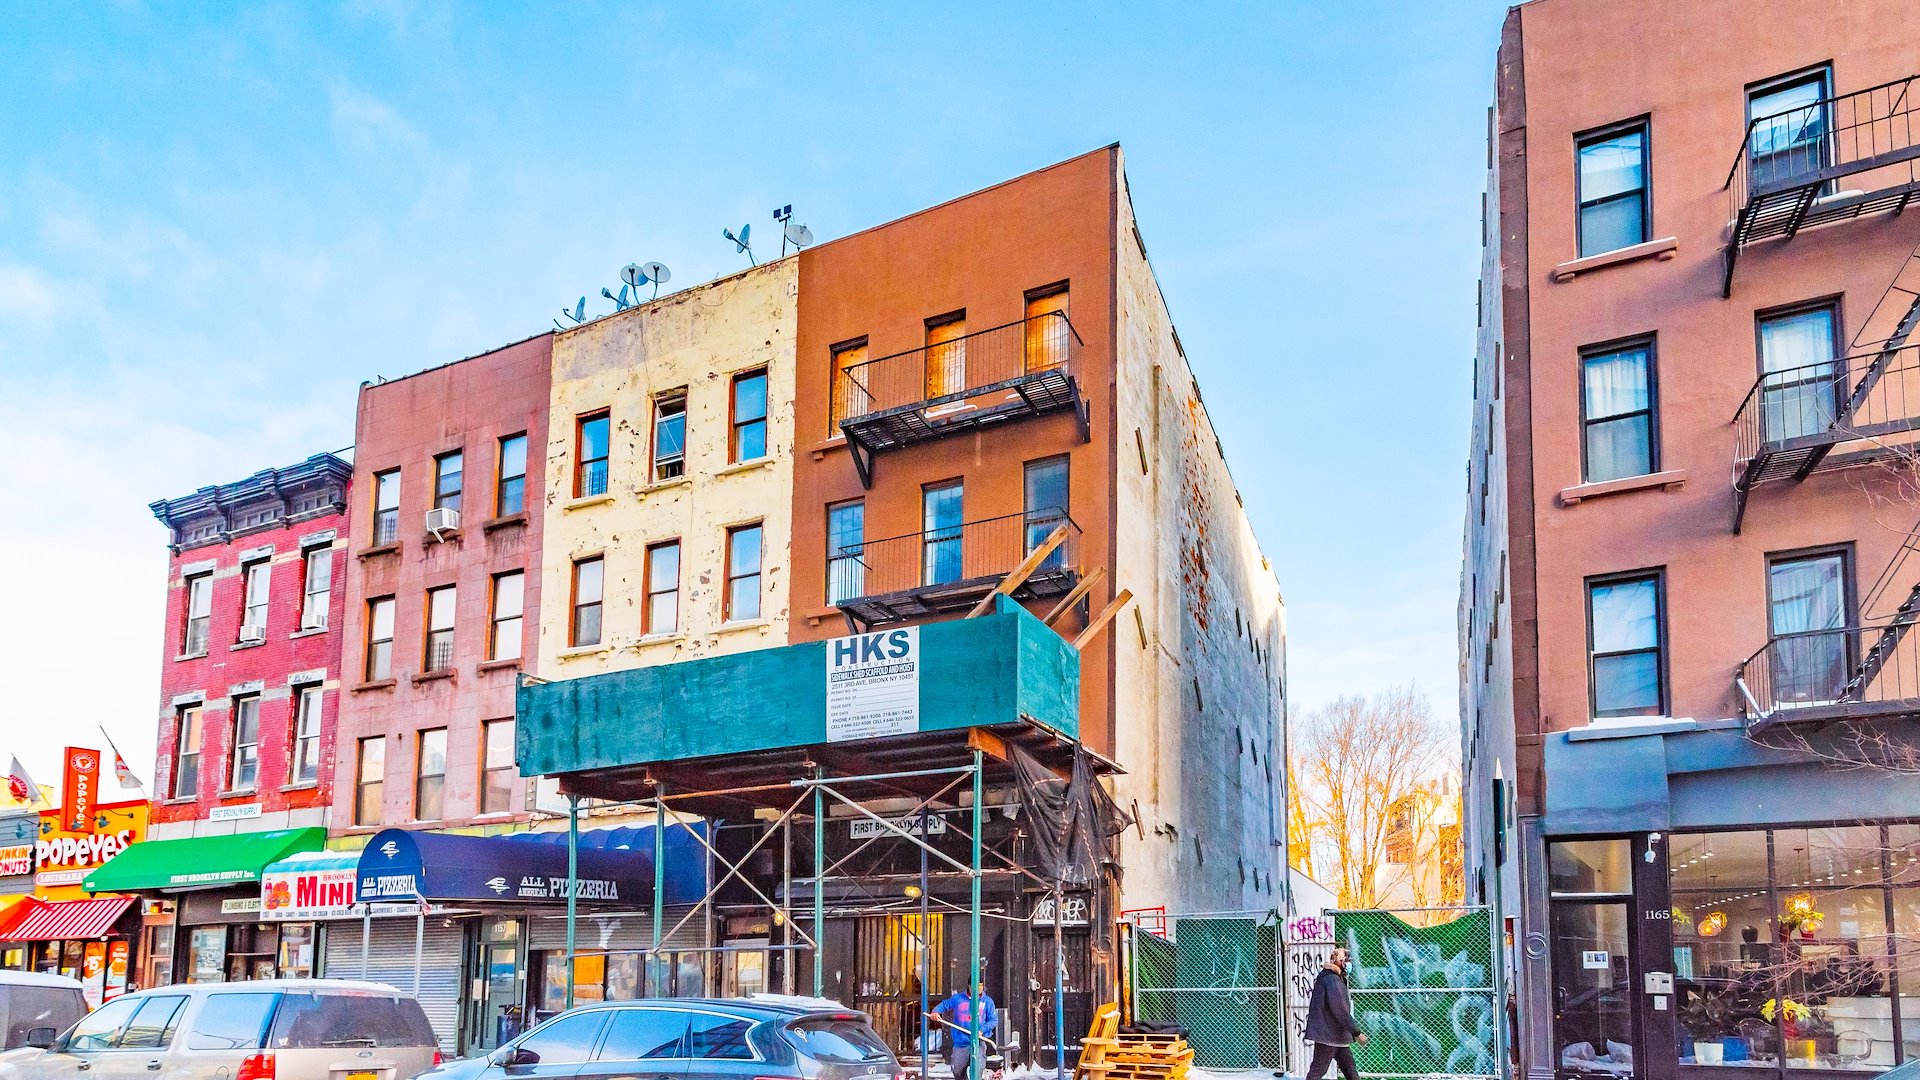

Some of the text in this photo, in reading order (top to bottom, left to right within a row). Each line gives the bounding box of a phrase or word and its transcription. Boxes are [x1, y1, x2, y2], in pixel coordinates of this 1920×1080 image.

[835, 630, 910, 666] HKS
[835, 657, 911, 672] CONSTRUCTION
[866, 666, 888, 677] SCAFFOLD
[832, 682, 843, 690] 2511
[869, 677, 889, 685] BRONX
[212, 806, 258, 818] FIRST BROOKLYN SUPPLY
[853, 822, 873, 835] FIRST
[915, 818, 942, 830] SUPLY
[0, 847, 31, 860] UNKIN'
[0, 860, 28, 875] ONUTS
[170, 874, 187, 883] FIRST
[188, 872, 220, 882] BROOKLYN
[220, 870, 243, 880] SUPPLY
[323, 872, 357, 882] BROOKLYN
[361, 877, 376, 888] ALL
[520, 875, 545, 887] ALL
[296, 875, 354, 908] MINI
[376, 874, 416, 896] PIZZERIA
[517, 887, 548, 898] AMERICAN
[1645, 909, 1670, 920] 1165
